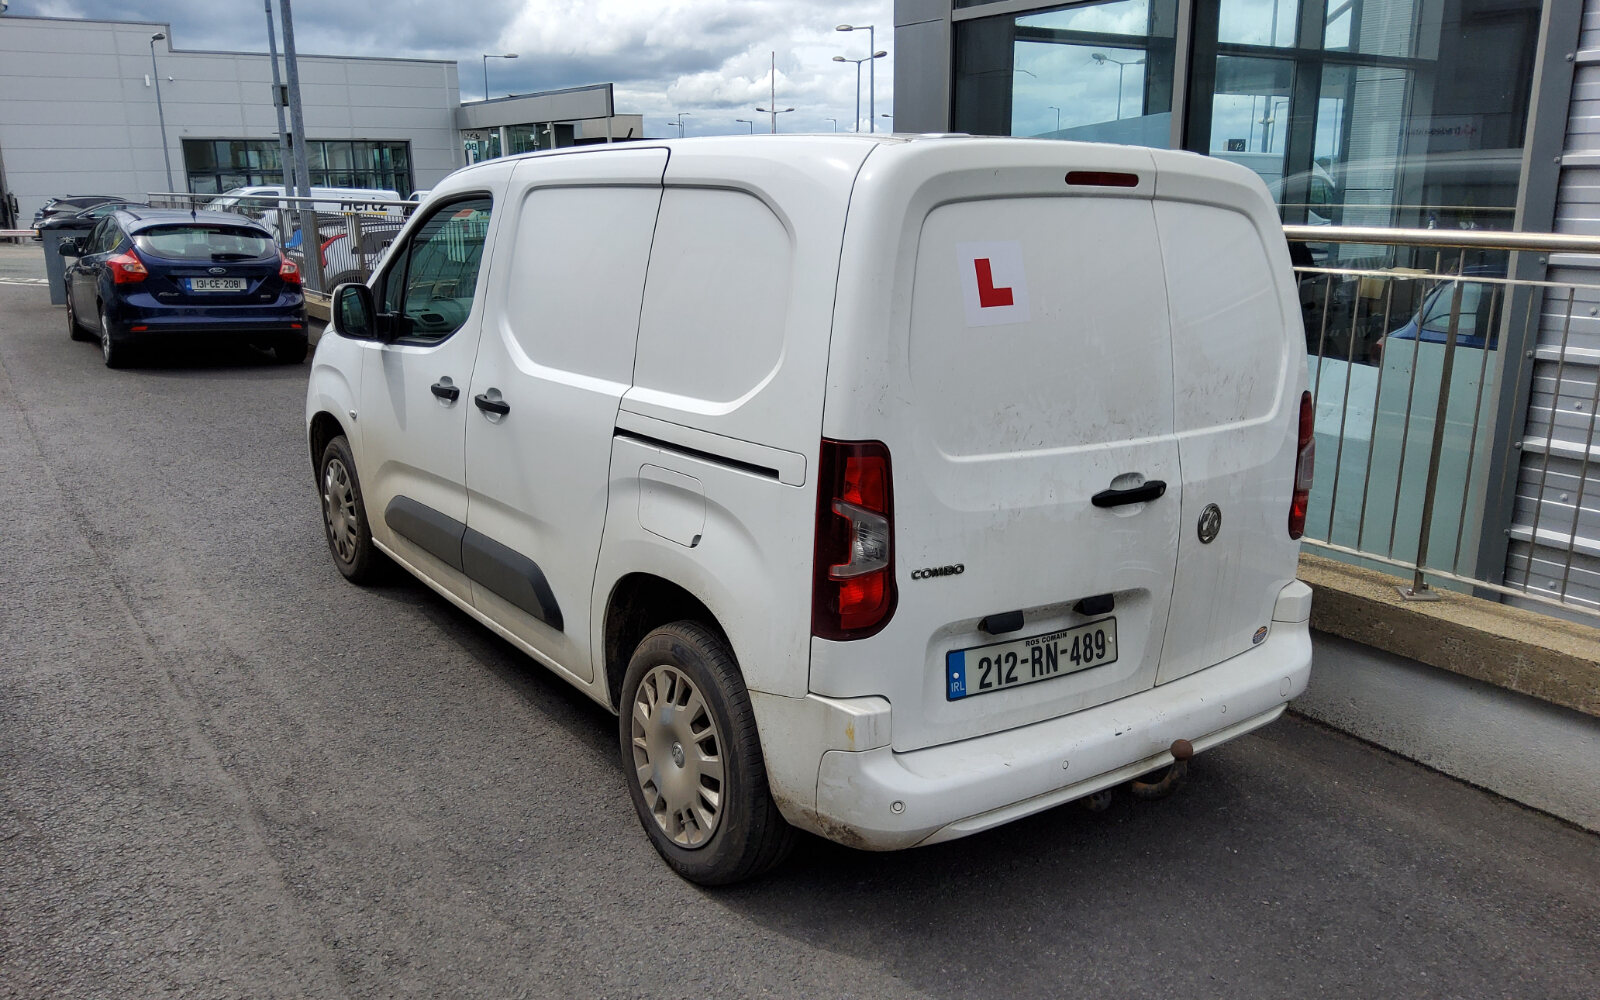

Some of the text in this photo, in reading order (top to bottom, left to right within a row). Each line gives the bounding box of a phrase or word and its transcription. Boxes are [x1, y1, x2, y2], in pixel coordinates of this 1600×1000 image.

[974, 258, 1014, 308] L
[911, 563, 964, 580] COMBO
[1025, 638, 1040, 647] ROS
[978, 629, 1106, 689] 212-RN-489
[951, 681, 965, 692] IRL
